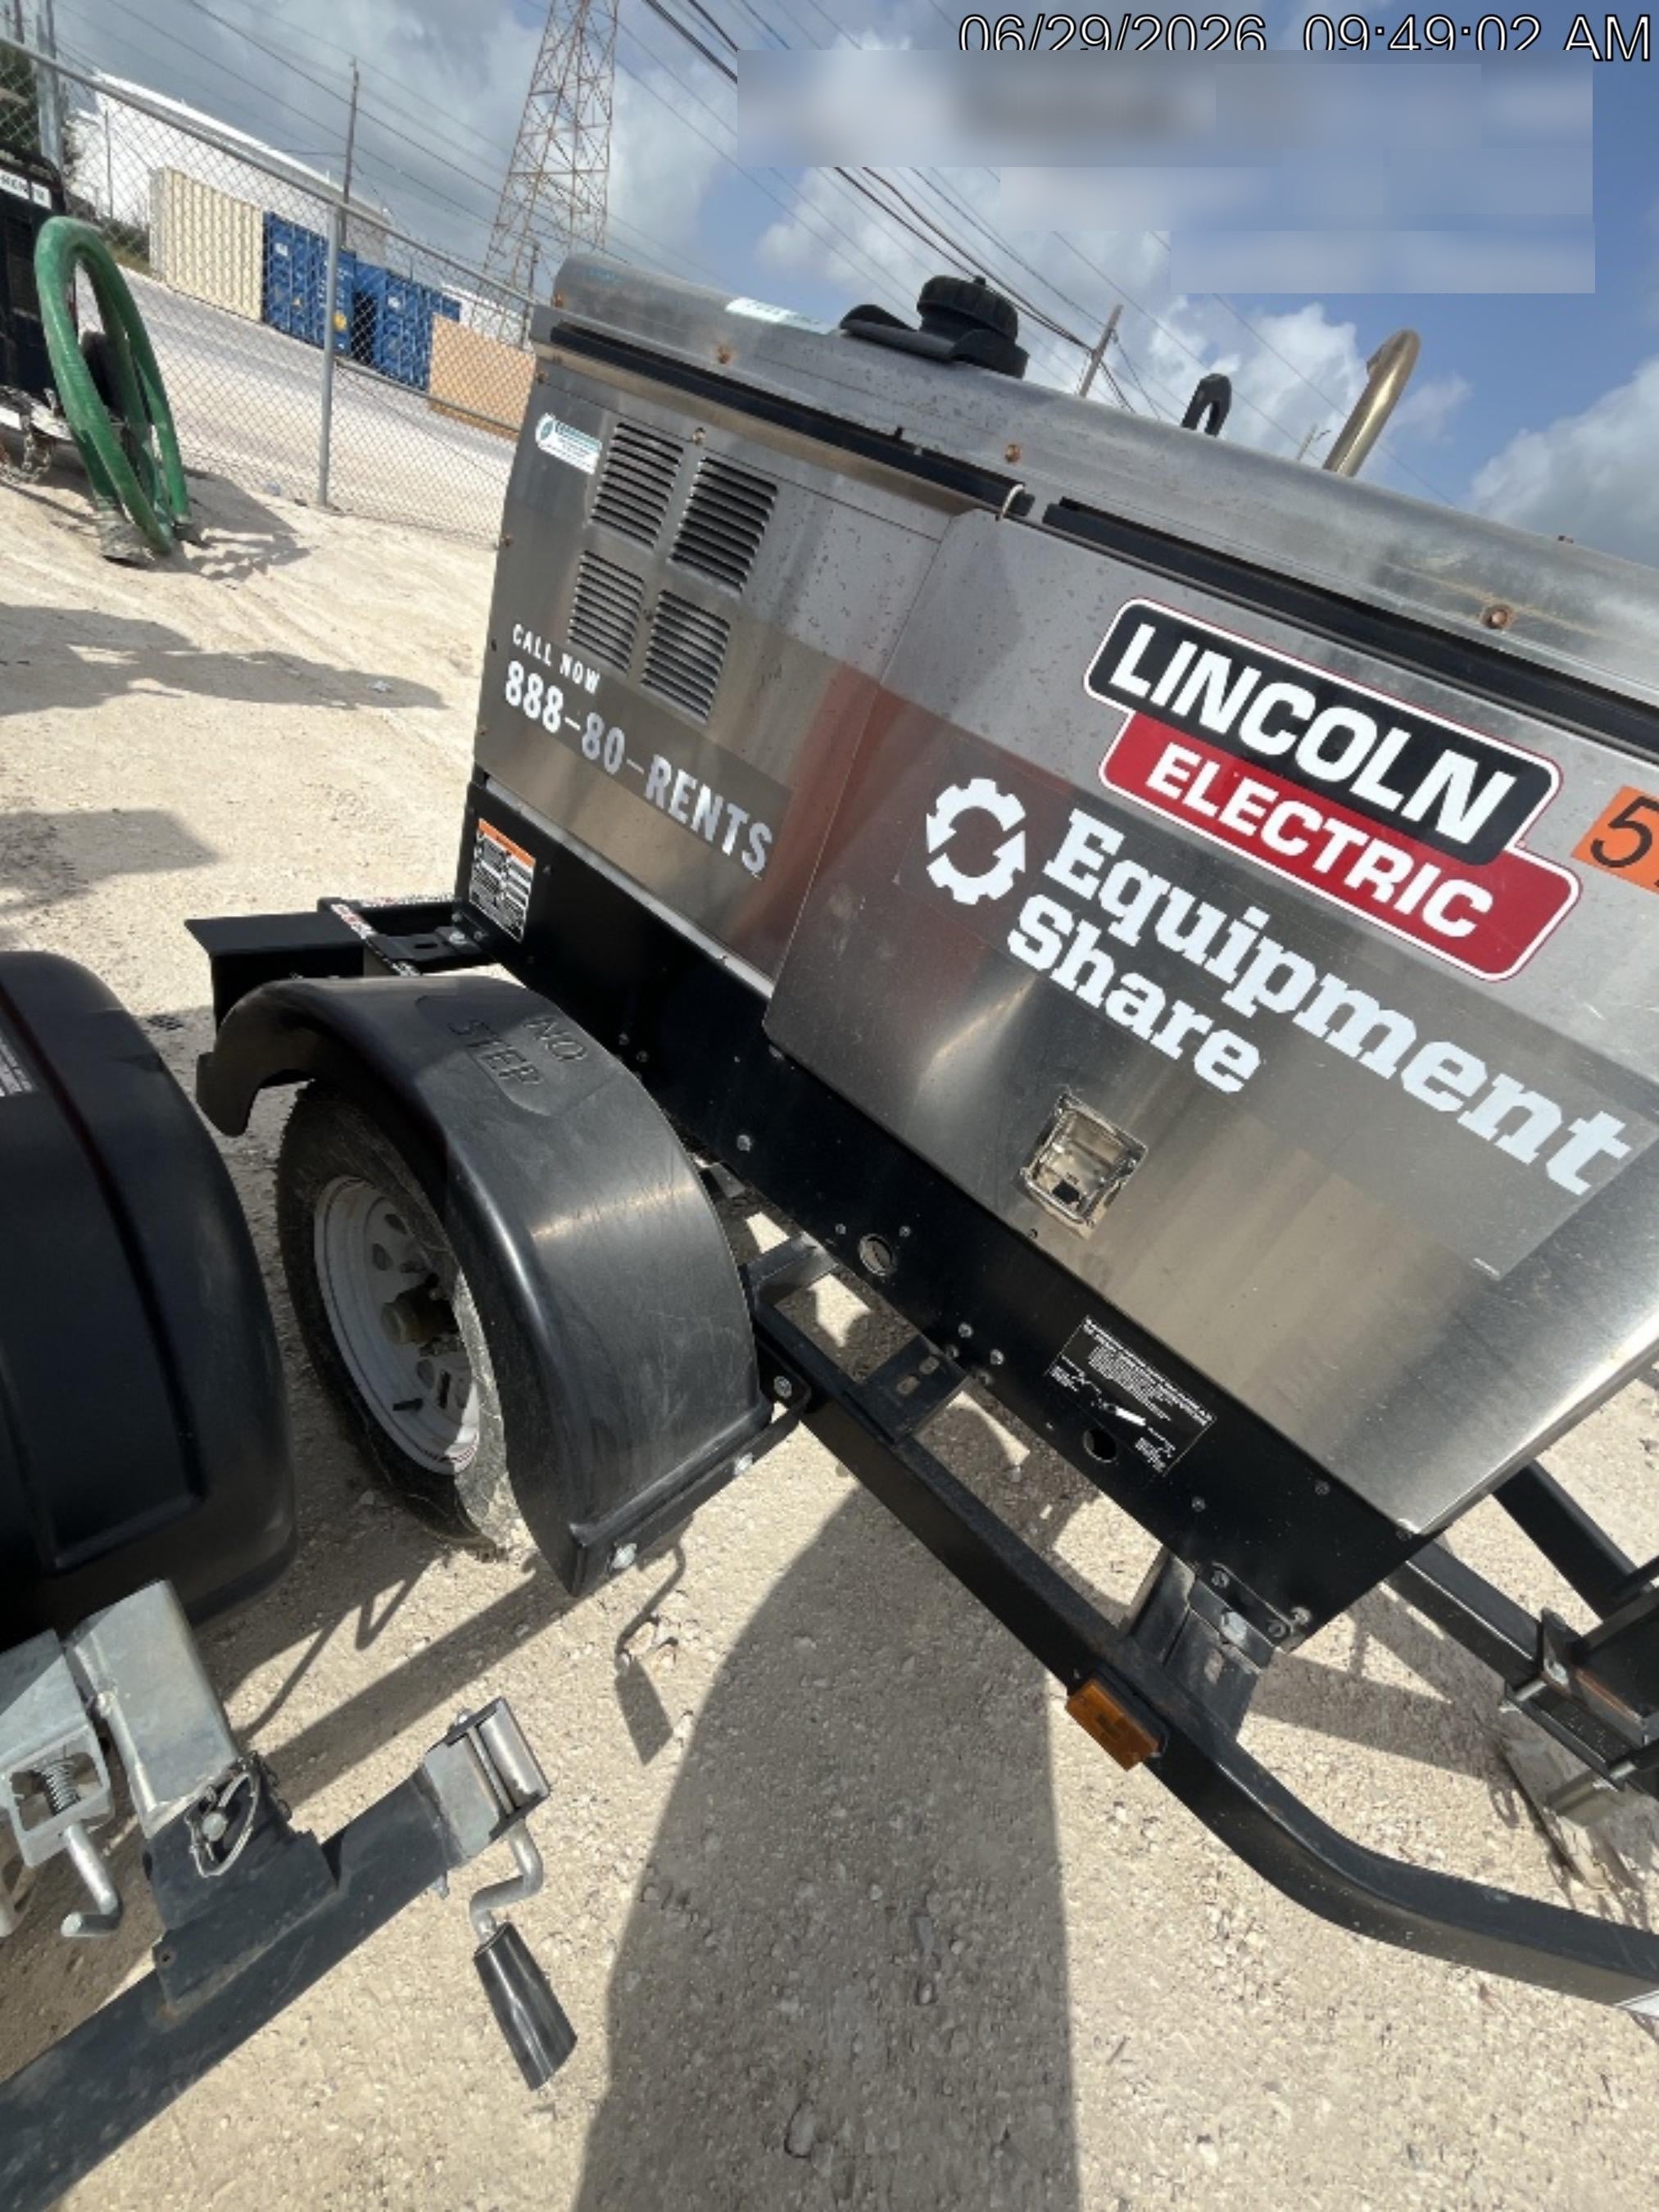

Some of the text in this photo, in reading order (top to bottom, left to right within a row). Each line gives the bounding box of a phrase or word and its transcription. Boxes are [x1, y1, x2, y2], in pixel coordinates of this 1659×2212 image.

[513, 623, 601, 695] CALL NOW
[1111, 624, 1515, 843] LINCOLN
[505, 660, 773, 880] 888-80-RENTS
[1147, 743, 1492, 936] ELECTRIC
[1590, 796, 1659, 887] 5
[523, 1017, 588, 1061] NO
[1009, 895, 1259, 1091] Share
[1044, 809, 1631, 1194] Equipment
